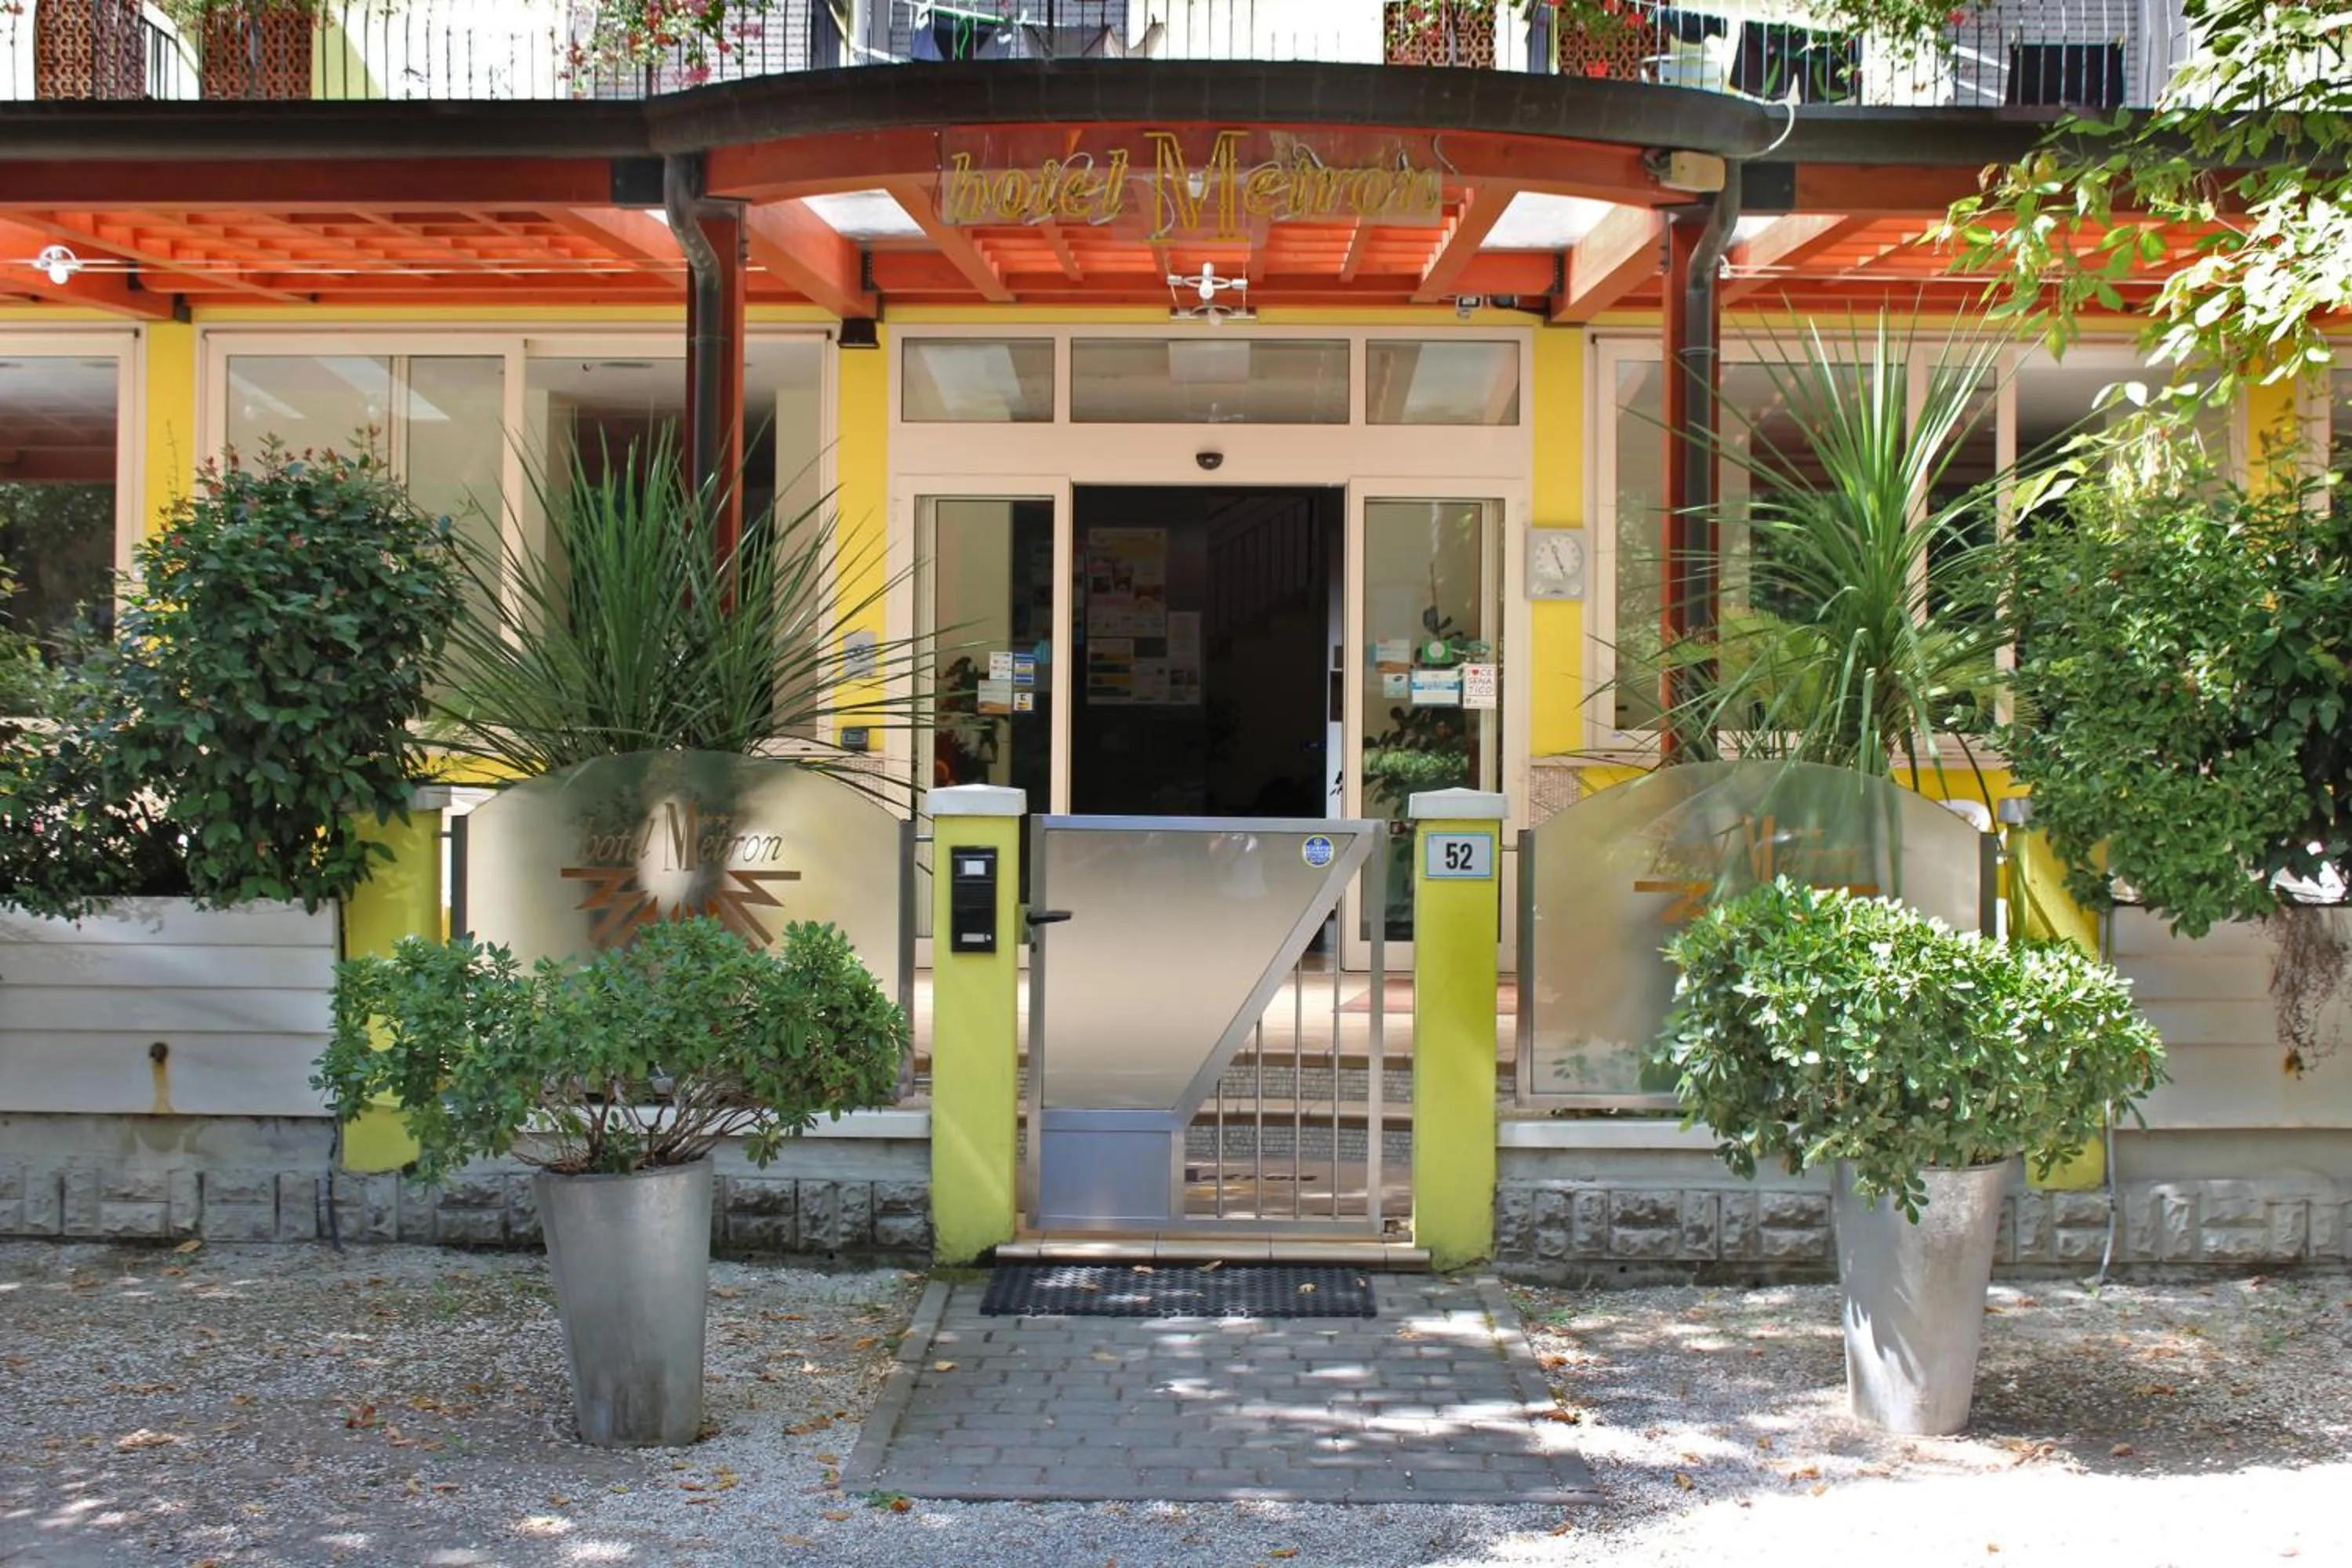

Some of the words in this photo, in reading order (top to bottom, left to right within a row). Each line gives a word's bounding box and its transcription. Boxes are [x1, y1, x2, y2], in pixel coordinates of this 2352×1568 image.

[949, 148, 1129, 220] hotel
[578, 816, 656, 863] hotel
[664, 802, 782, 872] Metron
[1445, 842, 1472, 870] 52
